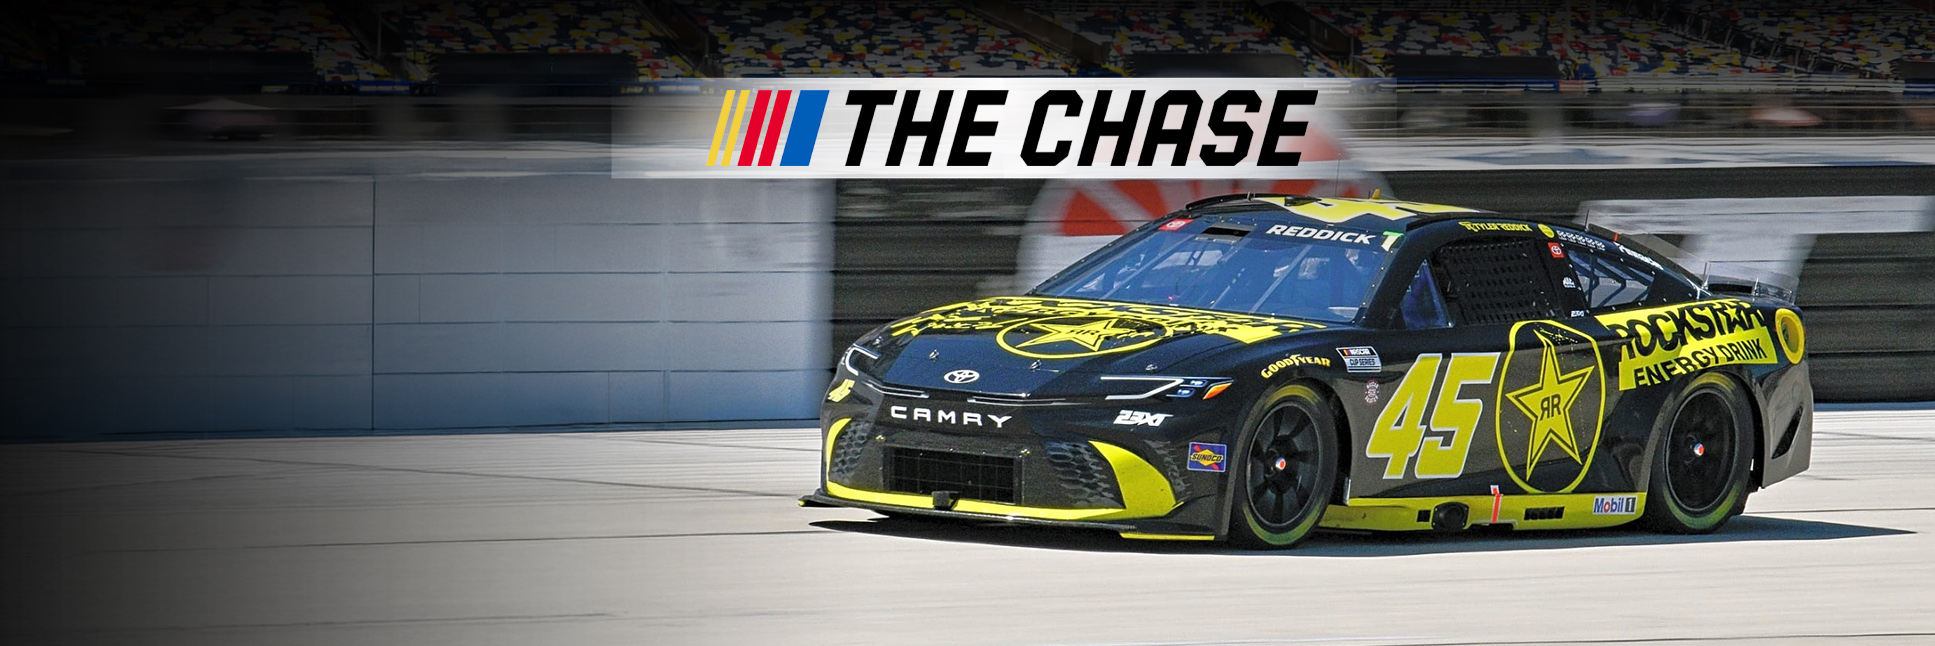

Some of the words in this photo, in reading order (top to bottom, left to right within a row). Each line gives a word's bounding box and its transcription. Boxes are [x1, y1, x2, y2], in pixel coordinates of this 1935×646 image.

[1265, 224, 1377, 245] REDDICK
[1605, 300, 1767, 360] ROCKSTAR
[1260, 354, 1331, 379] GOODYEAR
[1633, 345, 1722, 387] ENERGY
[1718, 338, 1768, 362] DRINK
[890, 405, 1013, 429] CAMRY
[1366, 353, 1501, 480] 45
[1191, 453, 1223, 462] SUNOCO
[1593, 497, 1624, 513] Mobil
